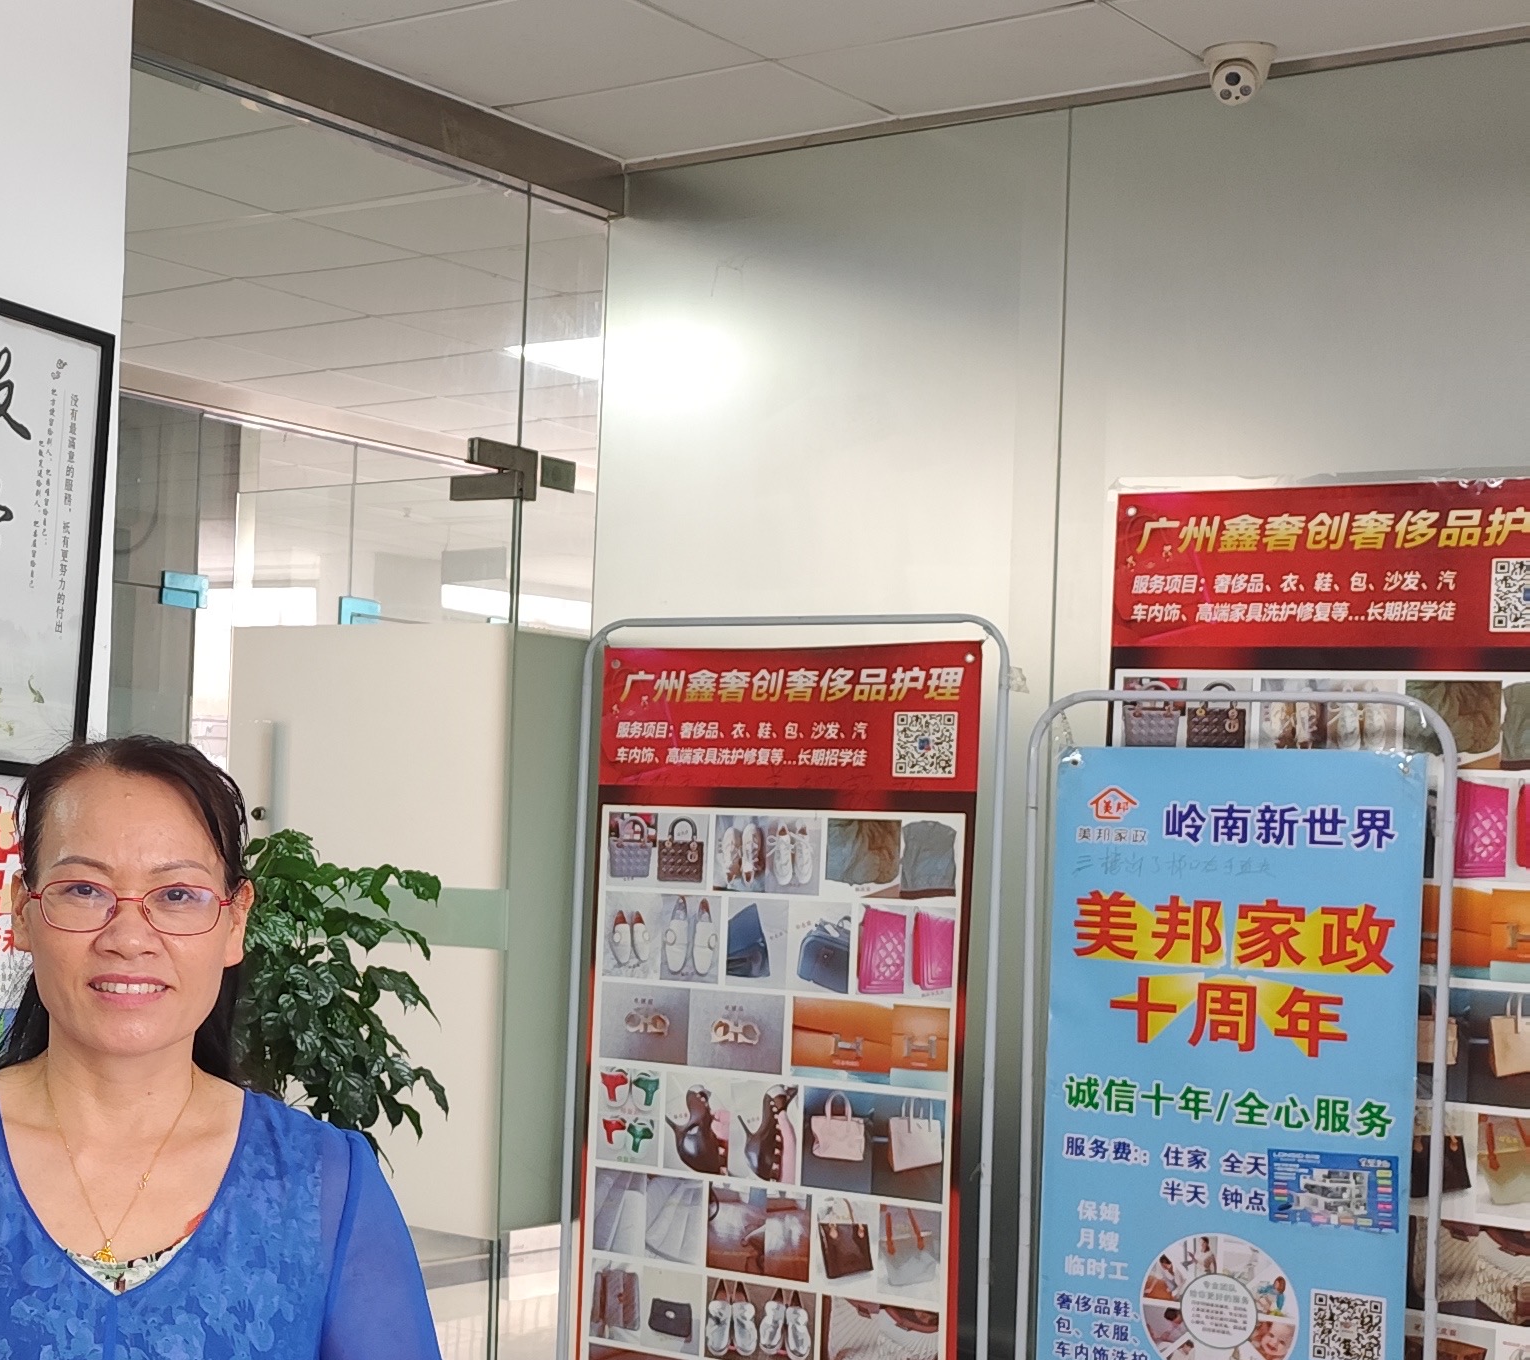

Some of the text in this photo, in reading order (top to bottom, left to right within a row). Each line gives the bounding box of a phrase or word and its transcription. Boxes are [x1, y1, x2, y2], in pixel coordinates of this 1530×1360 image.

[621, 666, 964, 703] 广州鑫奢创奢侈品护理
[1078, 827, 1147, 843] 美邦家政
[1165, 804, 1396, 849] 岭南新世界
[1074, 890, 1395, 974] 美邦家政
[1109, 977, 1348, 1058] 十周年
[1065, 1076, 1393, 1138] 诚信十年/全心服务
[1164, 1146, 1207, 1169] 住家
[1223, 1153, 1267, 1176] 全天
[1078, 1200, 1120, 1224] 保姆
[1162, 1181, 1266, 1212] 半天 钟点
[1077, 1229, 1120, 1253] 月嫂
[1065, 1255, 1129, 1281] 临时工
